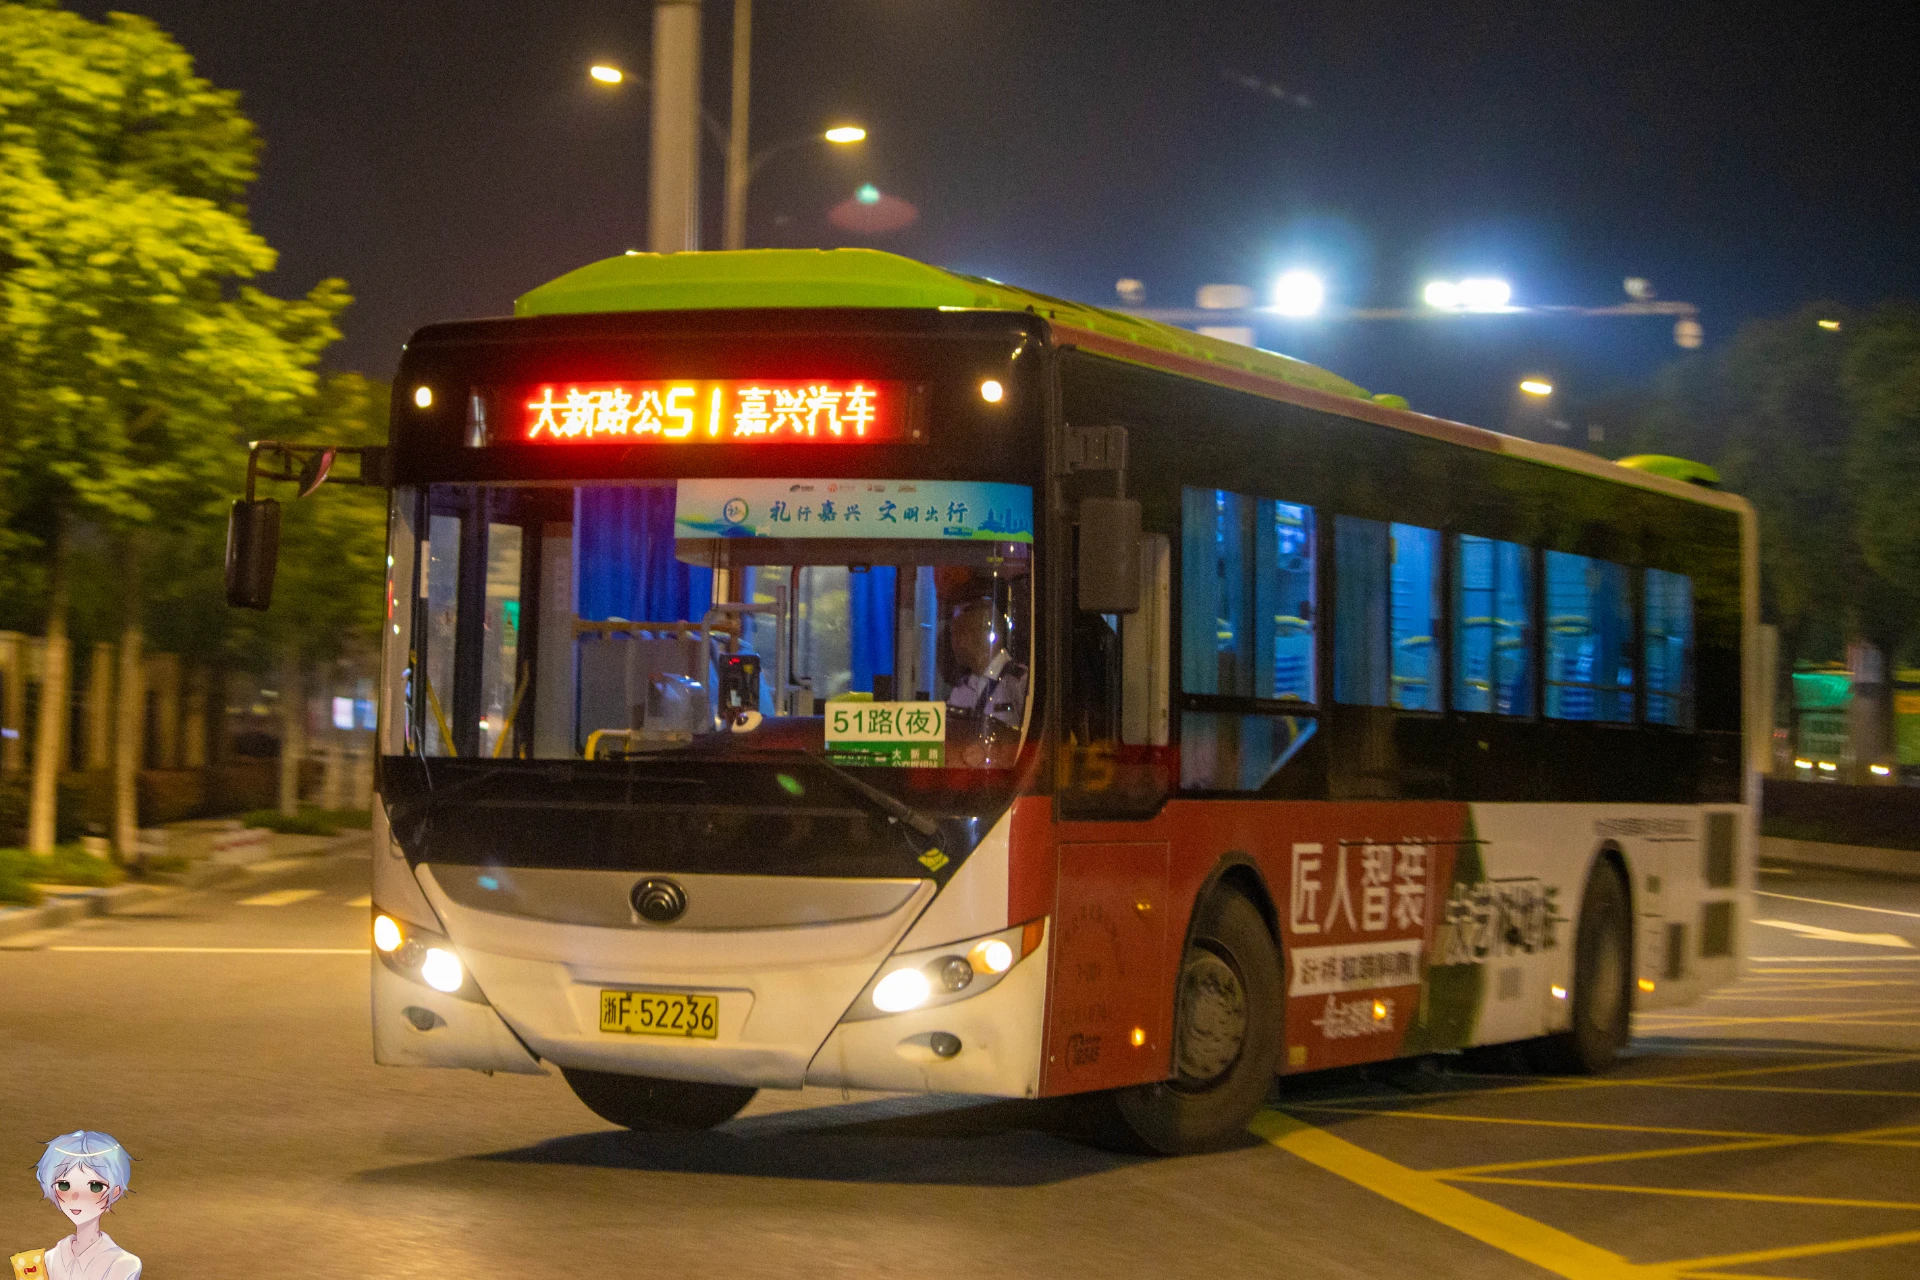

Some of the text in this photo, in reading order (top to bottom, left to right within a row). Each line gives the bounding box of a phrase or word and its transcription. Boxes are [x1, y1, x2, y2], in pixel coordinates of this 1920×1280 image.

[528, 385, 876, 438] 大新路公 51 嘉兴汽车
[875, 499, 968, 523] 文明出行
[833, 706, 942, 736] 51路(夜)
